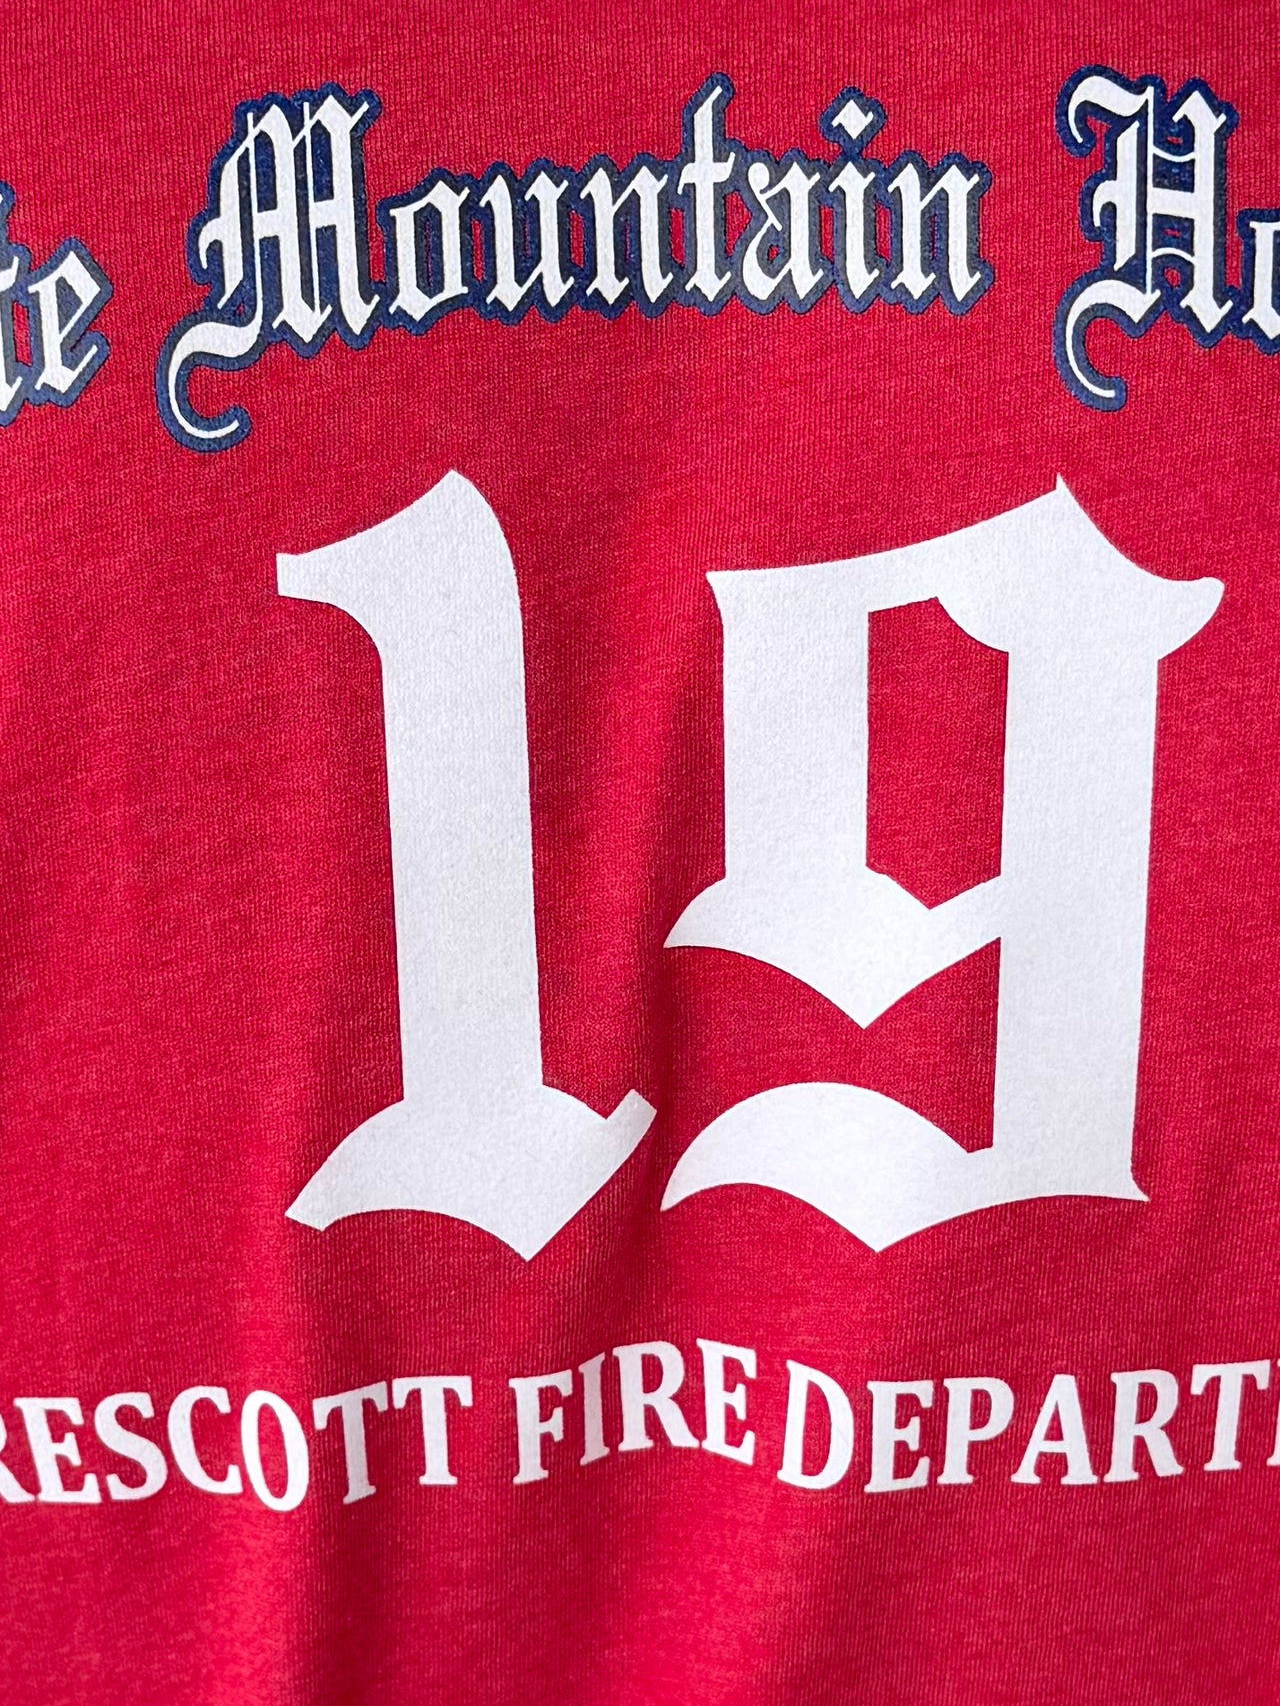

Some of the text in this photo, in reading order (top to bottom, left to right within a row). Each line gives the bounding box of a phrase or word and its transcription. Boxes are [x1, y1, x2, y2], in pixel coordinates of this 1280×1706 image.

[156, 73, 991, 450] Mountain
[276, 469, 1225, 1262] 19
[508, 1338, 757, 1484] FIRE
